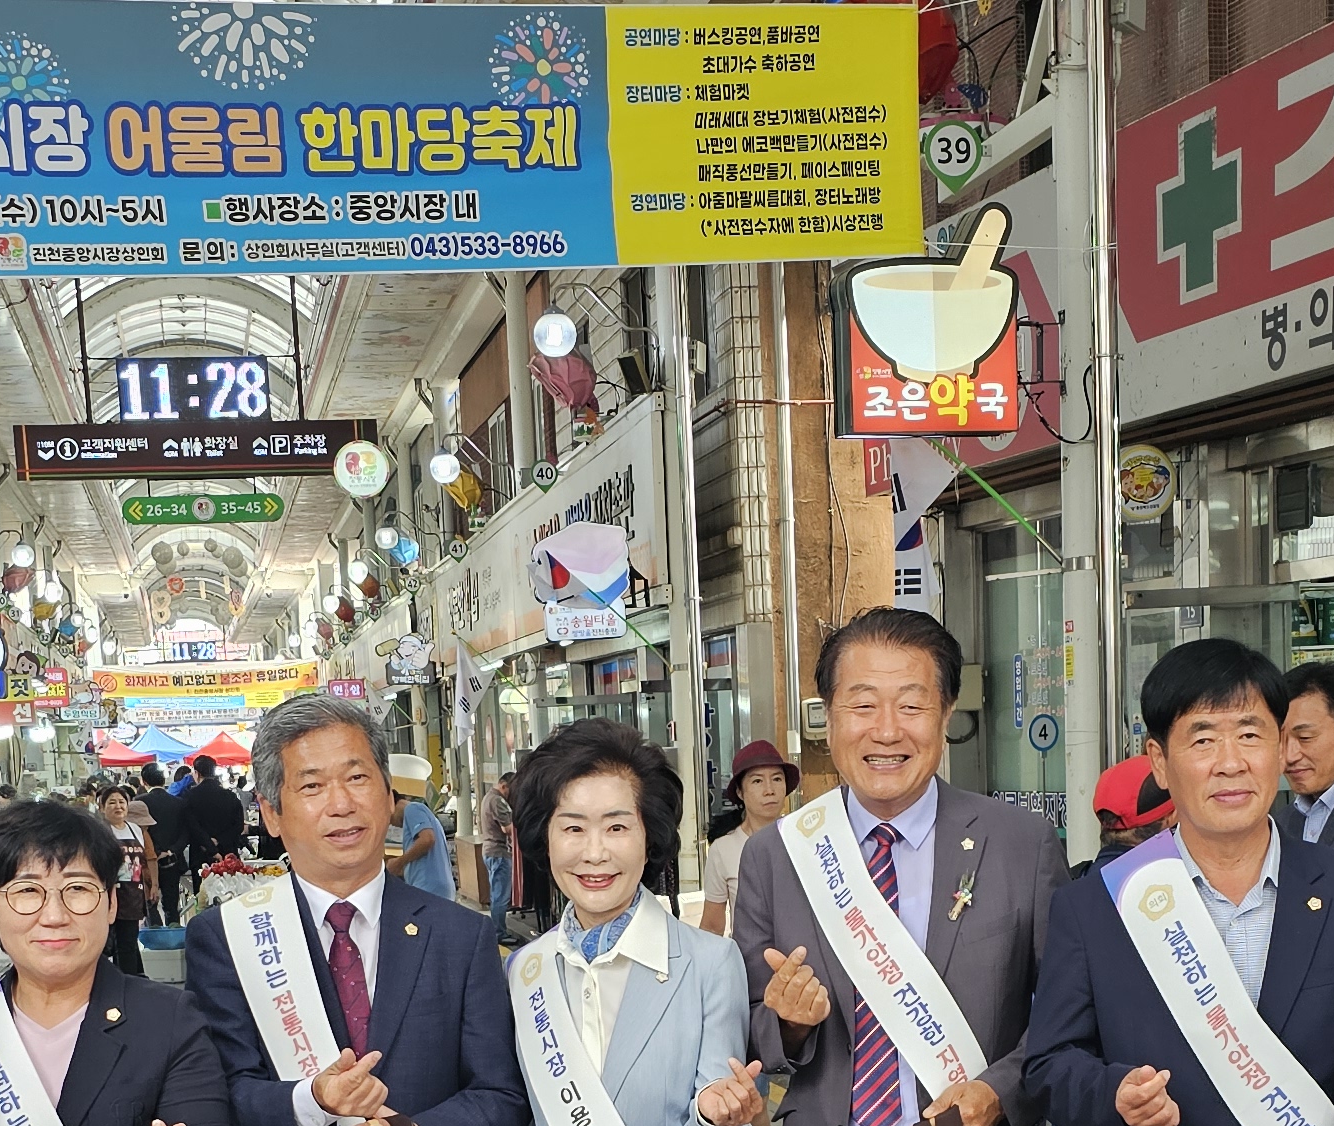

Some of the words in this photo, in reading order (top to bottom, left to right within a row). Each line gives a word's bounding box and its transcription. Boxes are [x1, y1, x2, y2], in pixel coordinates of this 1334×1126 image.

[625, 28, 681, 47] 공연마당
[693, 25, 820, 46] 버스킹공연,품바공연
[702, 56, 757, 75] 초대가수
[761, 53, 816, 73] 축하공연
[625, 85, 682, 104] 장터마당
[694, 84, 750, 102] 체험마켓
[694, 110, 749, 130] 미래세대
[753, 104, 888, 129] 장보기체험(사전접수)
[109, 104, 283, 174] 어울림
[300, 105, 580, 173] 한마당축제
[696, 138, 738, 155] 나만의
[741, 131, 889, 154] 에코백만들기(사전접수)
[937, 137, 972, 165] 39
[800, 160, 881, 180] 페이스페인팅
[48, 196, 166, 224] 10시~5시
[224, 196, 327, 223] 행사장소
[348, 193, 447, 222] 중앙시장
[453, 192, 479, 221] 내
[630, 193, 686, 212] 경연마당
[814, 186, 881, 206] 장터노래방
[798, 213, 884, 235] 한함)시상진행
[31, 246, 165, 264] 진천중앙시장상인회
[245, 241, 406, 260] 상인회사무실(고객센터)
[410, 235, 566, 257] 043)533-8966
[120, 362, 268, 419] 11:28
[863, 374, 1009, 428] 조은약국
[81, 438, 148, 452] 고객지원센터
[204, 436, 238, 450] 화장실
[293, 434, 327, 447] 주차장
[536, 467, 553, 480] 40
[146, 503, 187, 517] 26~34
[221, 502, 262, 516] 35~45
[451, 544, 464, 554] 41
[10, 610, 19, 618] 31
[125, 675, 169, 687] 화재사고
[173, 674, 216, 687] 예고없고
[256, 668, 299, 682] 휴일없다
[1039, 723, 1048, 741] 4
[813, 834, 854, 909] 실천하는
[843, 911, 905, 986] 물가안정
[893, 982, 946, 1047] 건강한
[248, 911, 288, 989] 함께하는
[272, 989, 320, 1080] 전통시장
[1162, 921, 1218, 1006] 실천하는
[1205, 1003, 1271, 1092] 물가안정
[528, 987, 567, 1078] 전통시장
